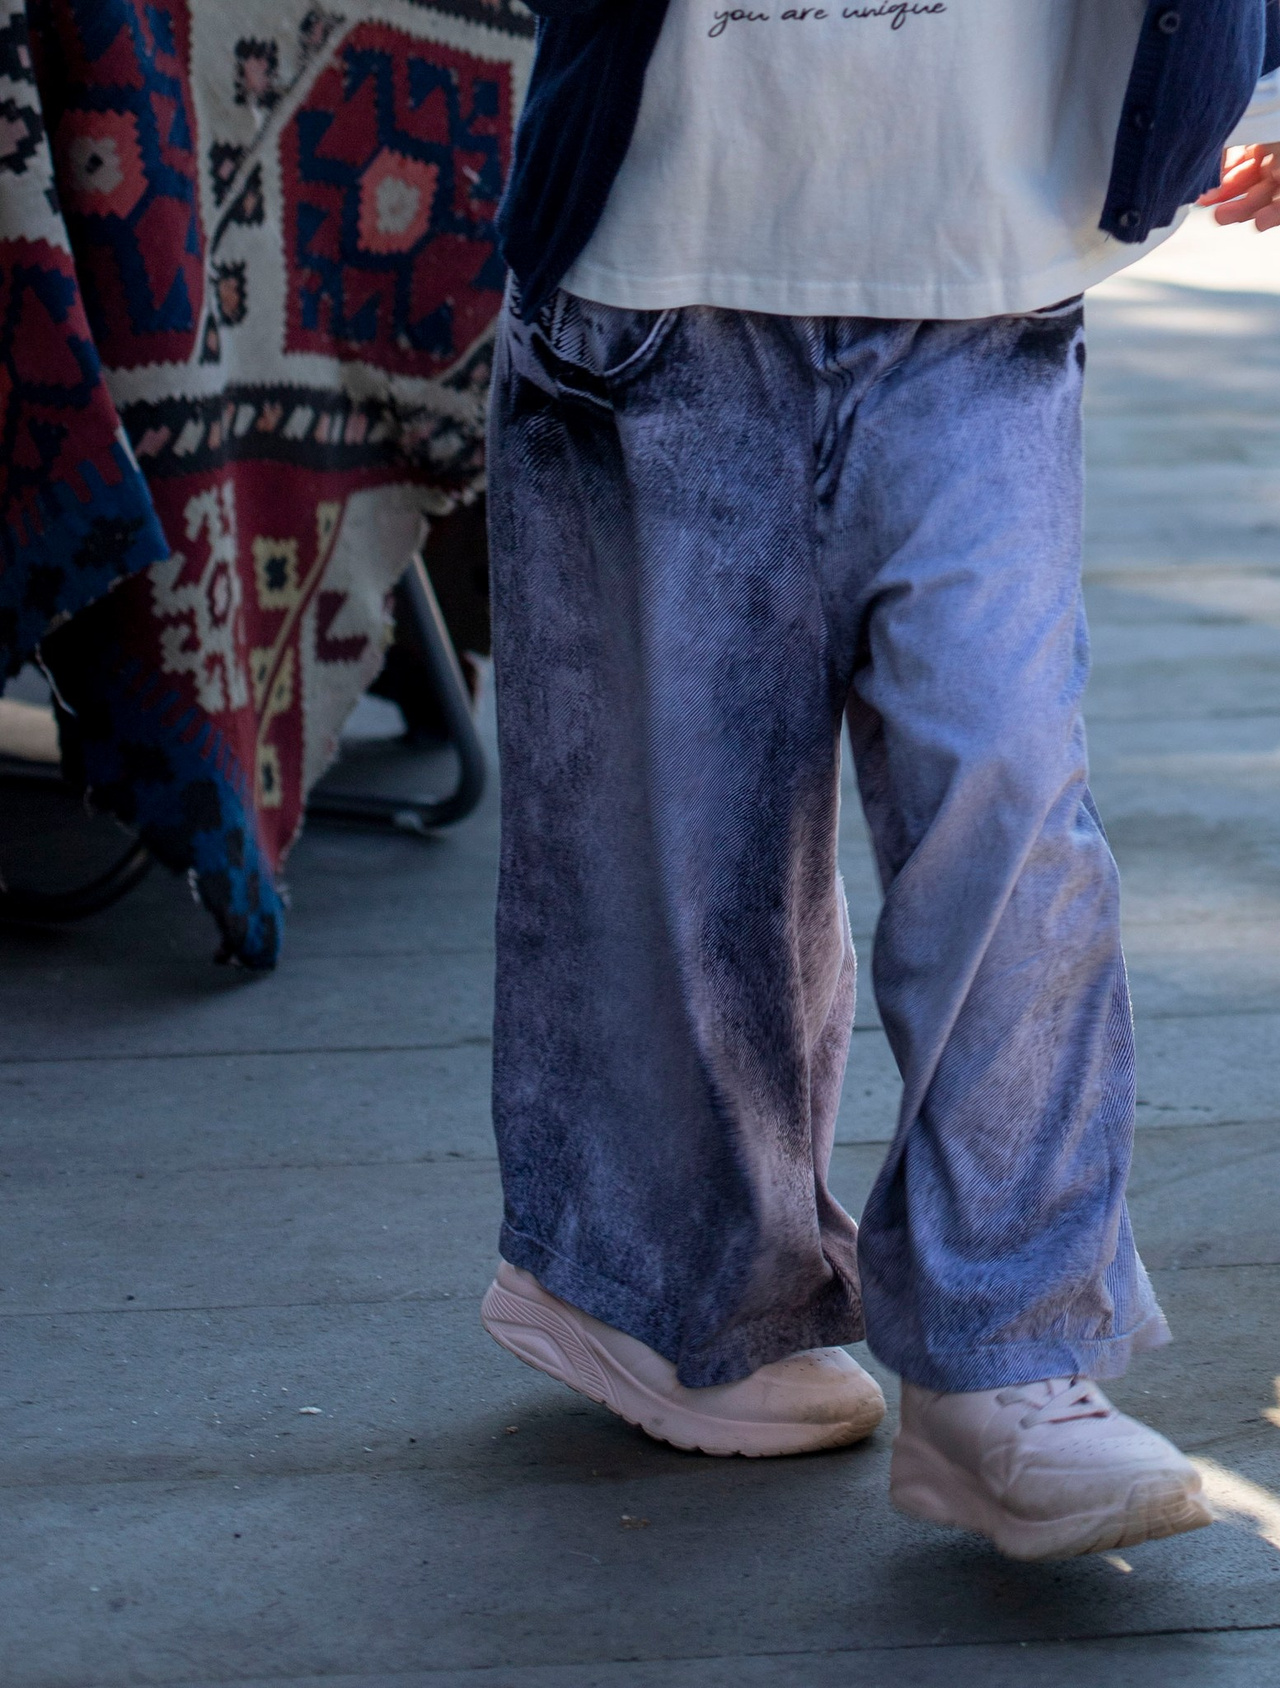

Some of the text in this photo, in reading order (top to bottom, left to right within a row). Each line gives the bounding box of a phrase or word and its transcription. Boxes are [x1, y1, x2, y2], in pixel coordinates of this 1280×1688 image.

[707, 0, 949, 38] you are unique
